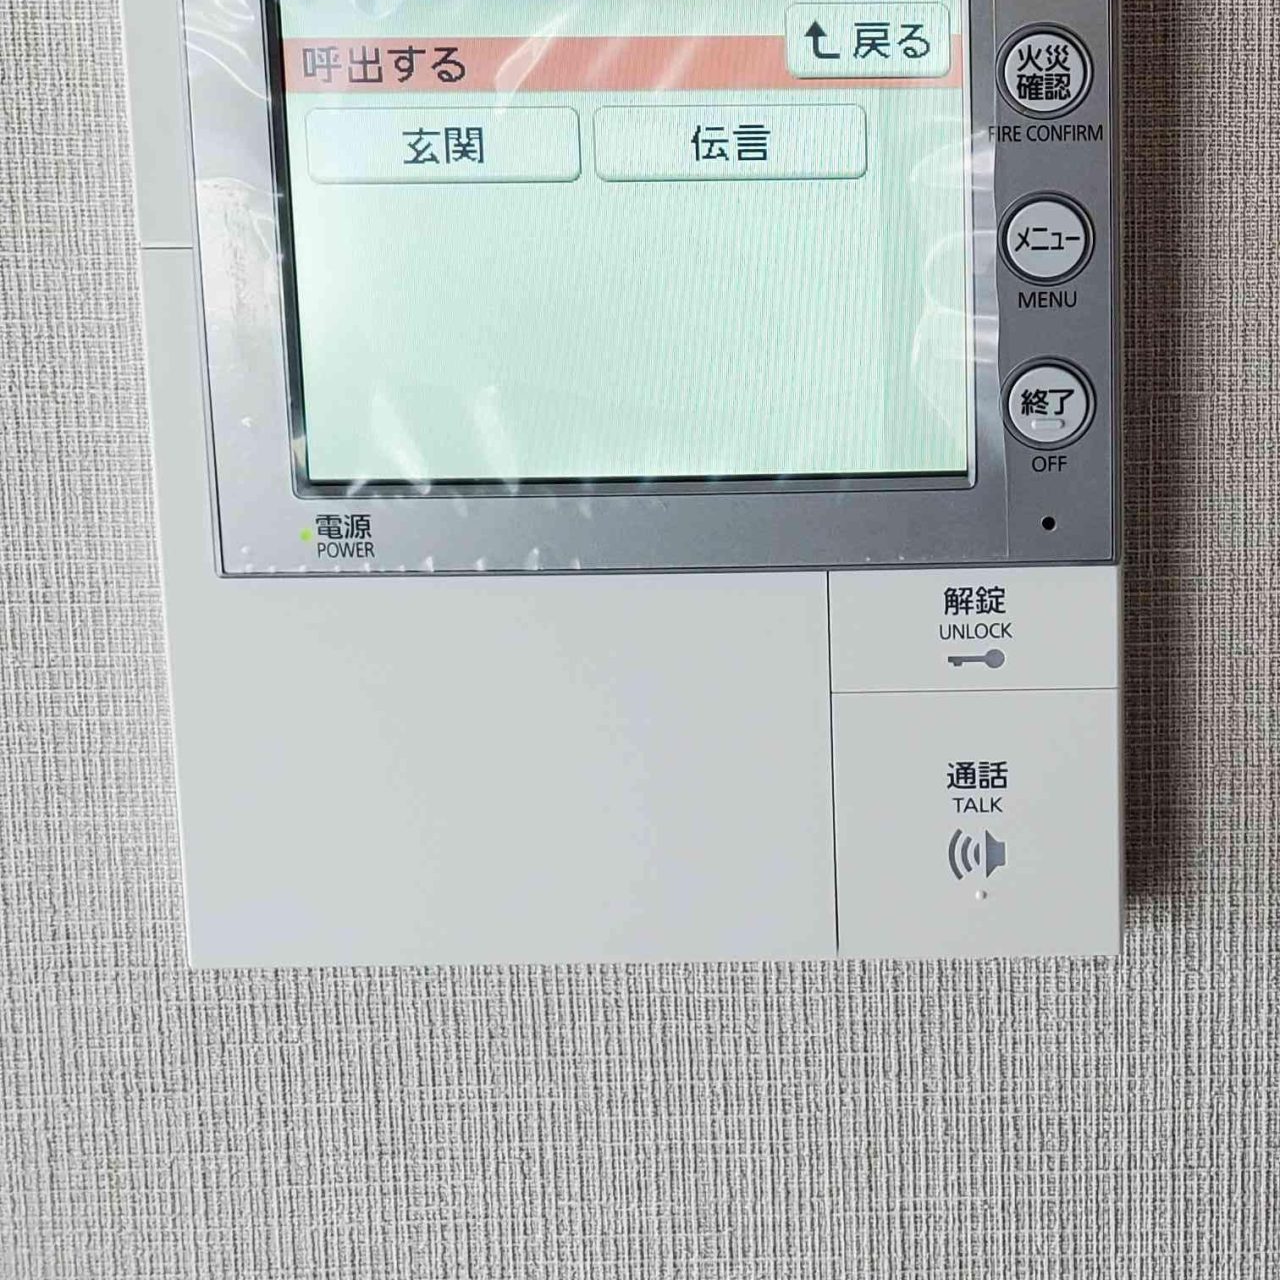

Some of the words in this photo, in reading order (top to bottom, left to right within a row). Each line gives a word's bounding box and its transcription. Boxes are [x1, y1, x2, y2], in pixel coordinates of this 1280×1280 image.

[852, 22, 931, 58] 戻る
[302, 46, 467, 84] 呼出する
[1017, 44, 1070, 72] 火災
[1016, 73, 1070, 100] 確認
[402, 127, 484, 164] 玄関
[691, 124, 771, 162] 伝言
[988, 126, 1021, 142] FIRE
[1027, 125, 1103, 141] CONFIRM
[1015, 227, 1080, 252] メニュー
[1018, 291, 1077, 308] MENU
[1021, 389, 1074, 416] 終了
[1032, 456, 1067, 472] OFF
[315, 515, 372, 539] 電源
[317, 542, 374, 558] POWER
[944, 586, 1006, 615] 解錠
[939, 622, 1012, 640] UNLOCK
[947, 761, 1008, 789] 通話
[952, 797, 1003, 813] TALK
